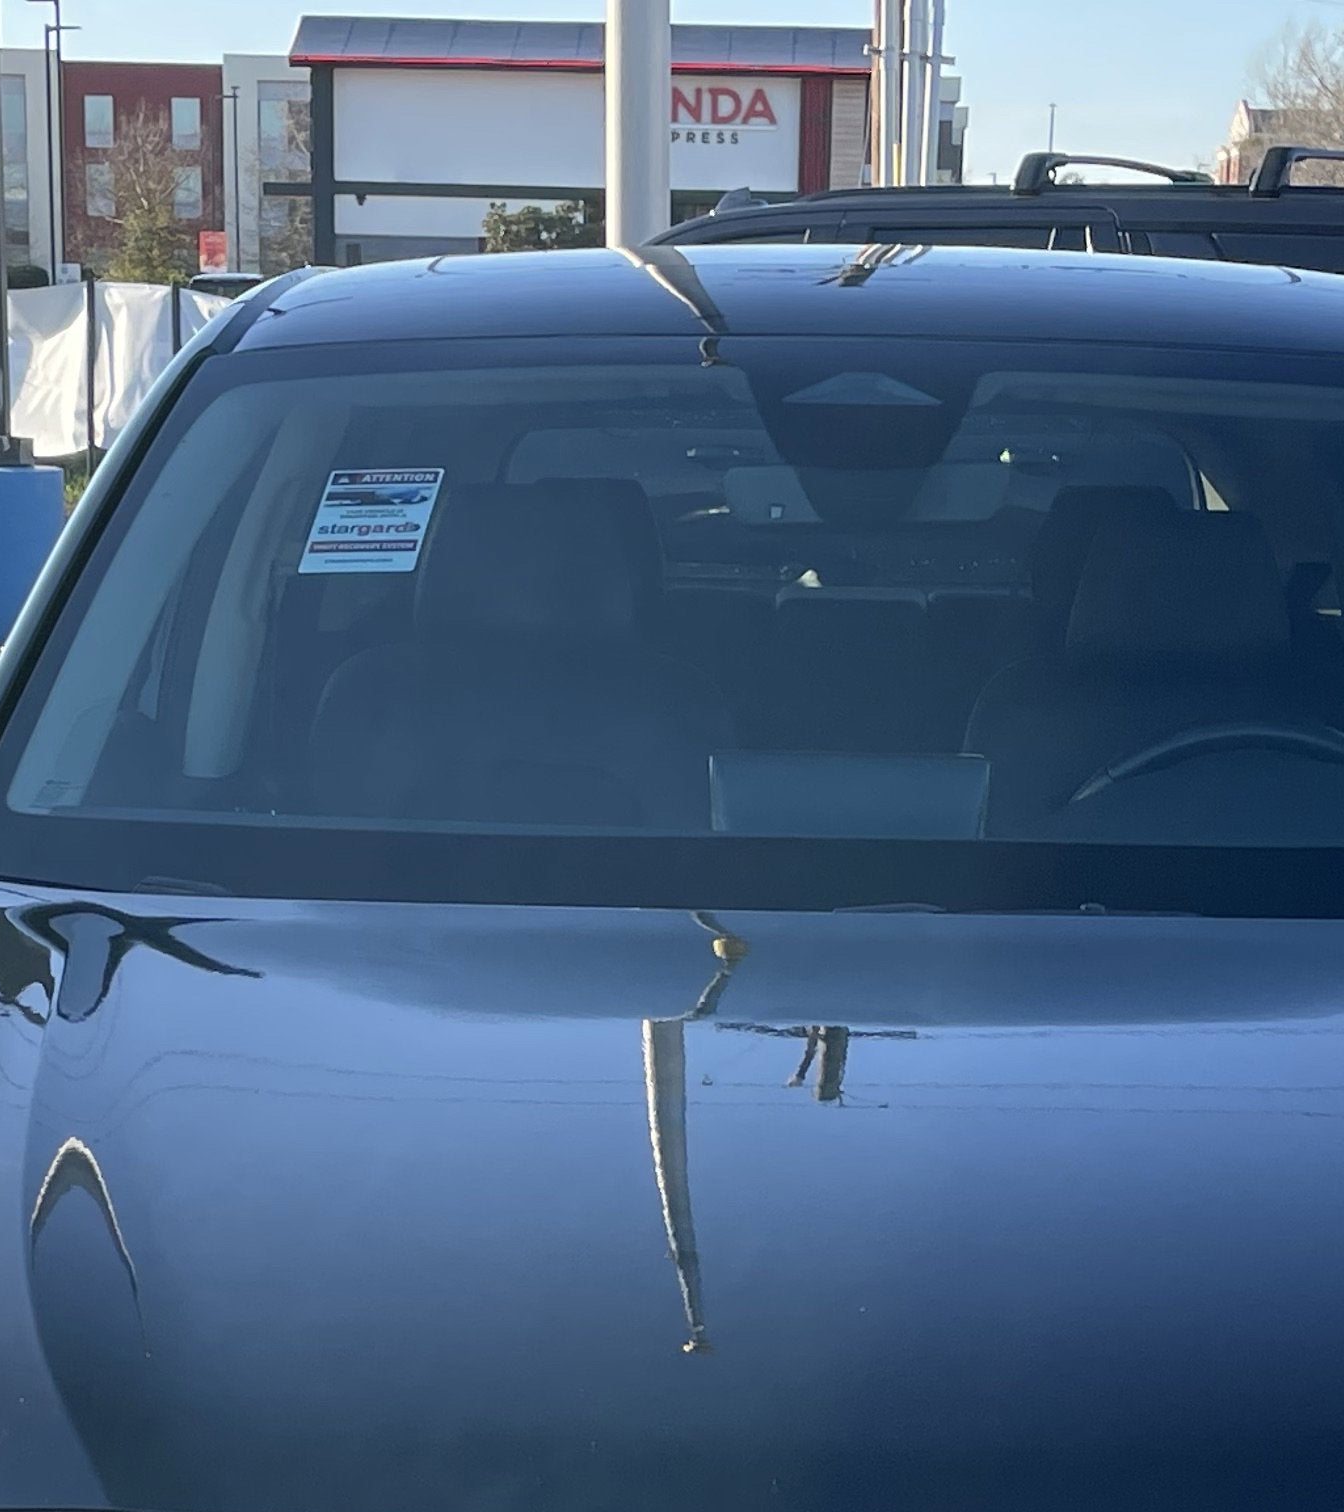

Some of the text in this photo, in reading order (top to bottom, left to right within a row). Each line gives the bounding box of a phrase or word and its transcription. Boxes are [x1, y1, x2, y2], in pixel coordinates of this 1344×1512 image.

[671, 86, 778, 125] NDA
[671, 131, 740, 144] PRESS
[360, 473, 436, 483] ATTENTION
[318, 522, 419, 536] stargard
